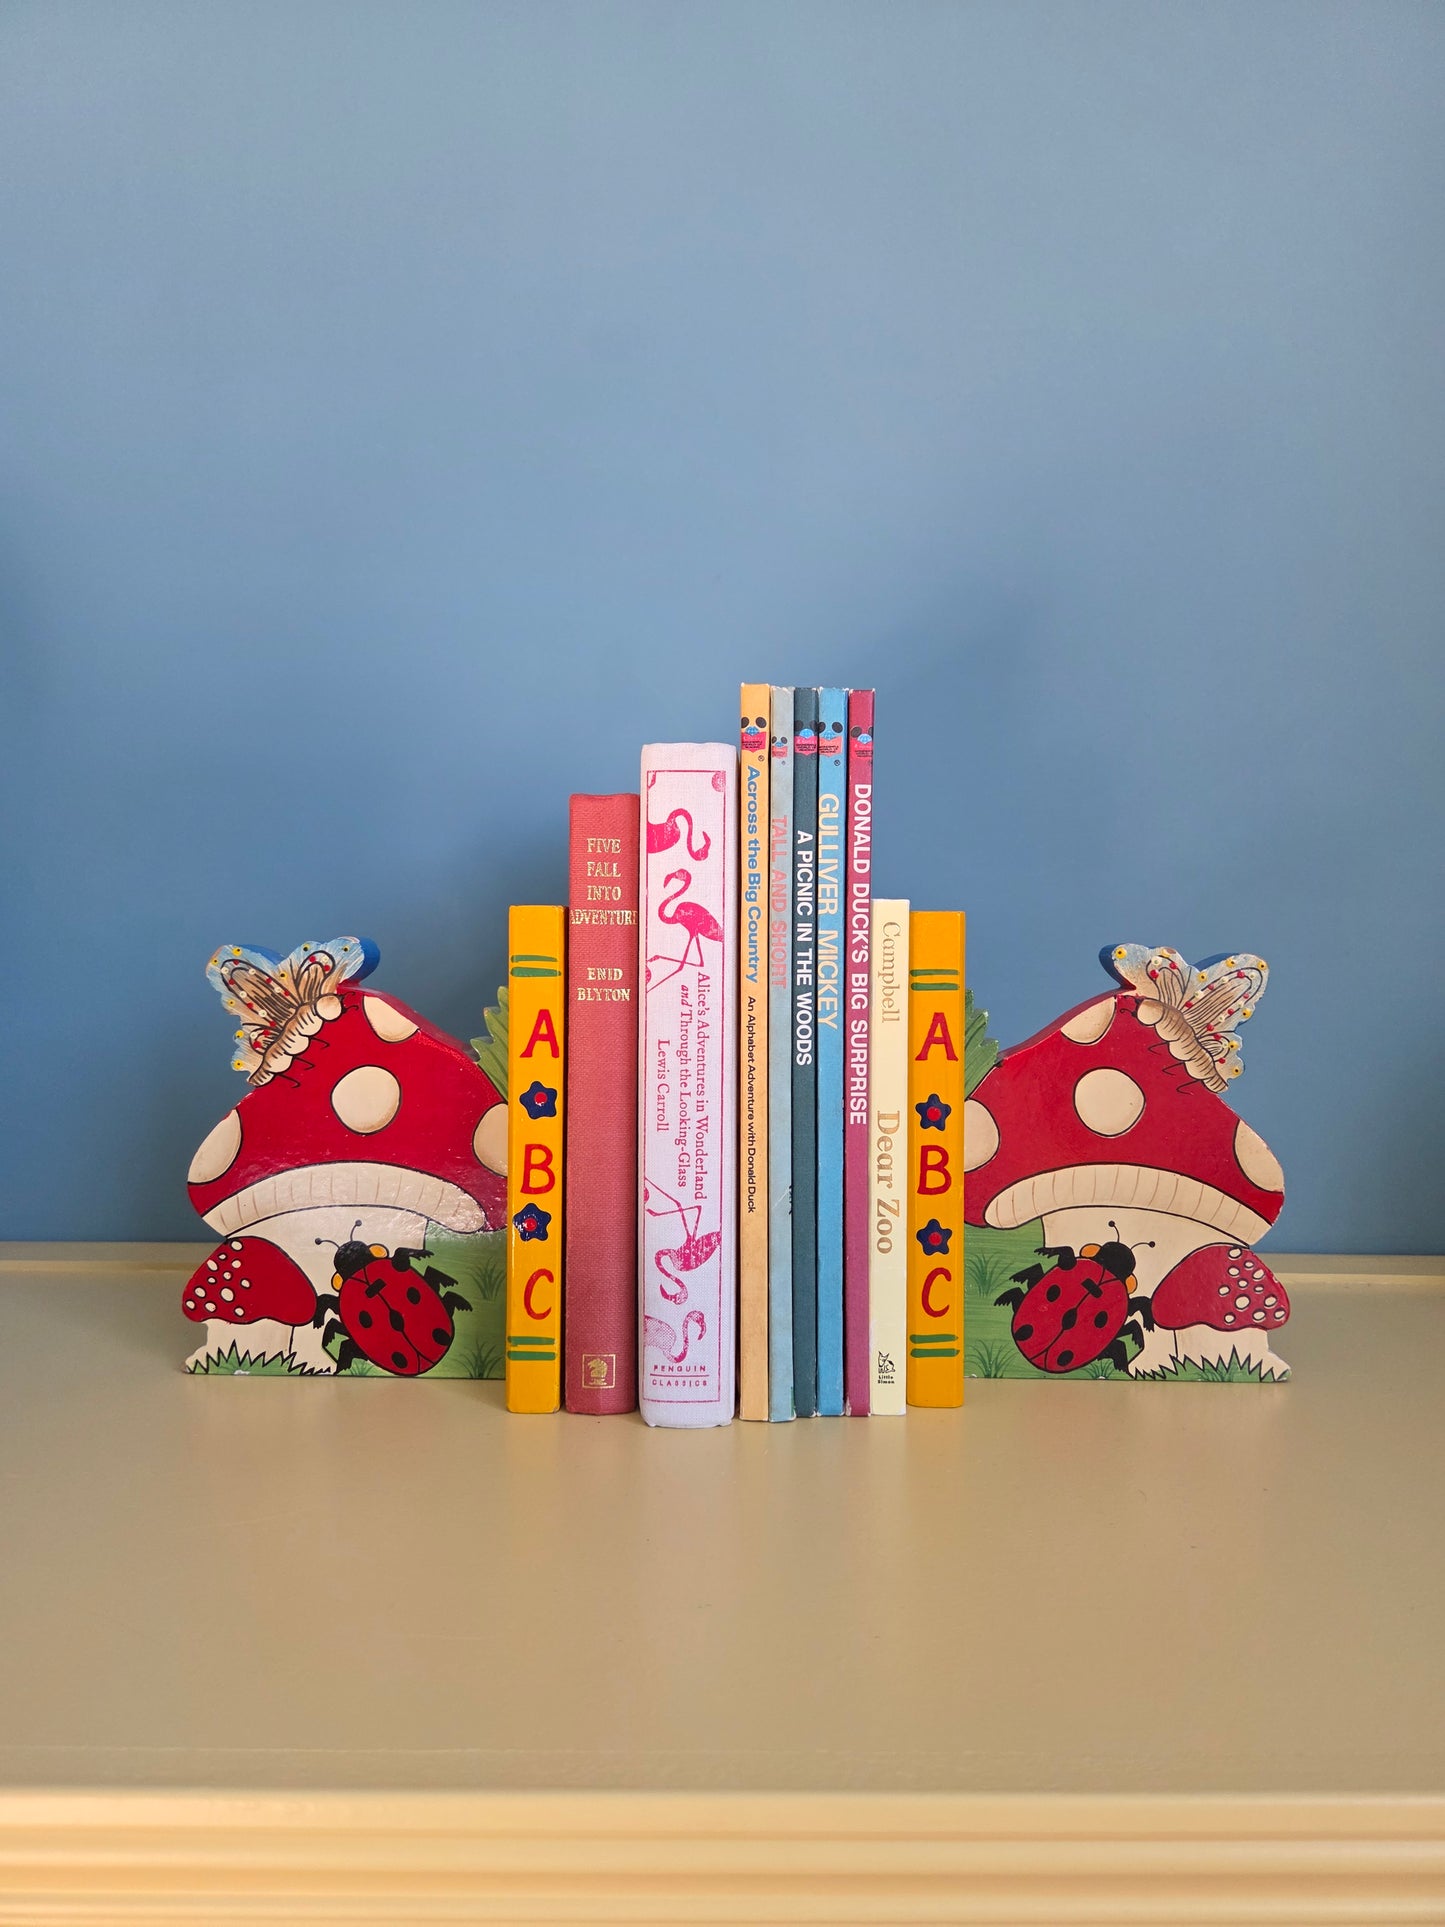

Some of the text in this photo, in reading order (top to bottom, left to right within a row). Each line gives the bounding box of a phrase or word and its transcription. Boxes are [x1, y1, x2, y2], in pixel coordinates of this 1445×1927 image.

[586, 838, 622, 853] FIVE
[747, 765, 761, 835] Across
[586, 862, 622, 877] FALL
[586, 885, 622, 901] INTO
[745, 872, 761, 902] Big
[748, 838, 761, 870] the
[746, 905, 762, 984] Country
[771, 814, 788, 990] TALL AND SHORT
[796, 830, 813, 1066] A PICNIC IN THE WOODS
[817, 793, 840, 1030] GULLIVER MICKEY
[577, 987, 631, 1002] BLYTON
[586, 967, 624, 981] ENID
[850, 783, 872, 1125] DONALD DUCK'S BIG SURPRISE
[877, 921, 902, 1023] Campbell
[656, 1039, 670, 1132] Lewis Carroll
[674, 984, 693, 1188] and Through the Looking-Glass
[694, 971, 711, 1200] Alice's Adventures in Wonderland
[746, 996, 756, 1214] An Alphabet Adventure with Donald Duck
[519, 1008, 560, 1320] A B C
[876, 1110, 901, 1255] Dear Zoo
[915, 1012, 959, 1318] A B C
[651, 1379, 707, 1387] CLASSICS
[653, 1364, 706, 1373] PENGUIN
